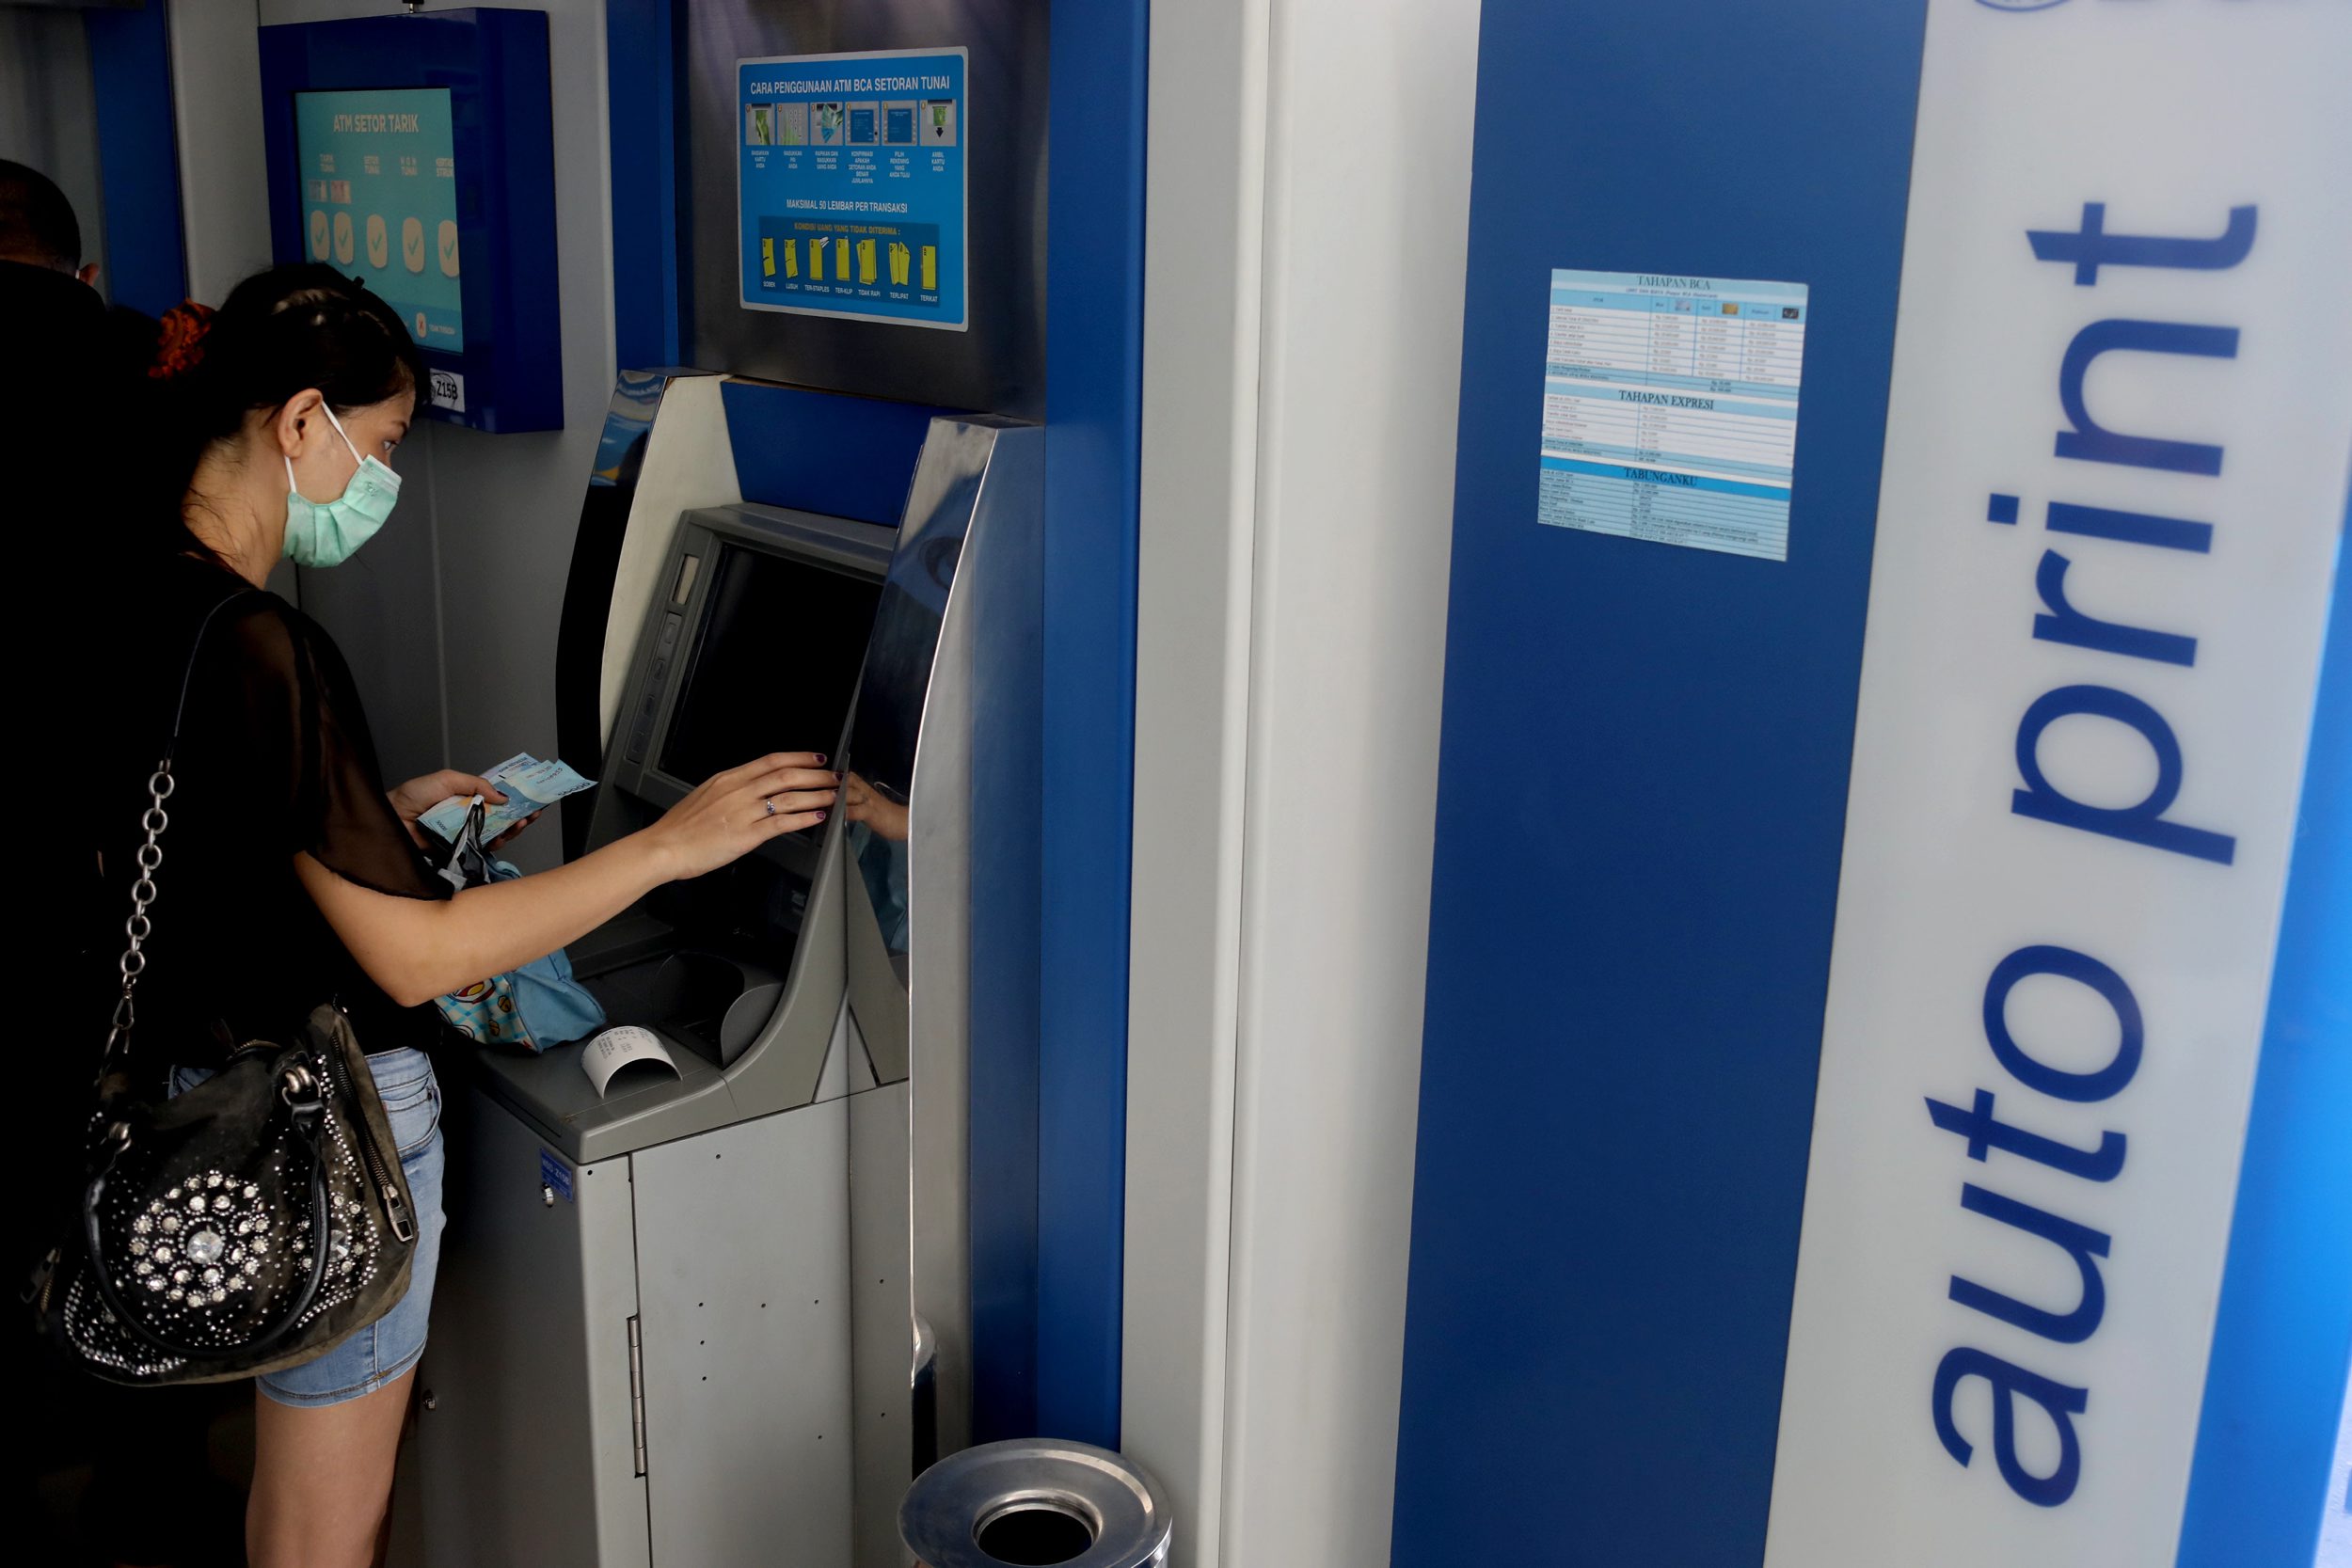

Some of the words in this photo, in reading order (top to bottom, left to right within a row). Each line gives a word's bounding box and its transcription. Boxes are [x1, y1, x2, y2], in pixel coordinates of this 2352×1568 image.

[750, 81, 772, 95] CARA
[774, 79, 832, 94] PENGGUNAAN
[834, 78, 851, 92] ATM
[853, 77, 873, 91] BCA
[875, 76, 918, 91] SETORAN
[920, 75, 950, 90] TUNAI
[333, 114, 354, 133] ATM
[354, 114, 387, 133] SETOR
[388, 113, 420, 133] TARIK
[787, 198, 818, 210] MAKSIMAL
[818, 199, 827, 210] 50
[827, 200, 854, 211] LEMBAR
[855, 201, 868, 212] PER
[869, 201, 908, 214] TRANSAKSI
[850, 225, 867, 233] TIDAK
[1637, 275, 1687, 289] TAHAPAN
[1689, 278, 1711, 291] BCA
[437, 380, 458, 401] Z15B
[1618, 389, 1669, 405] TAHAPAN
[1671, 395, 1715, 410] EXPRESI
[1624, 467, 1698, 486] TABUNGANKU
[1987, 202, 2257, 866] print
[1923, 944, 2146, 1508] auto
